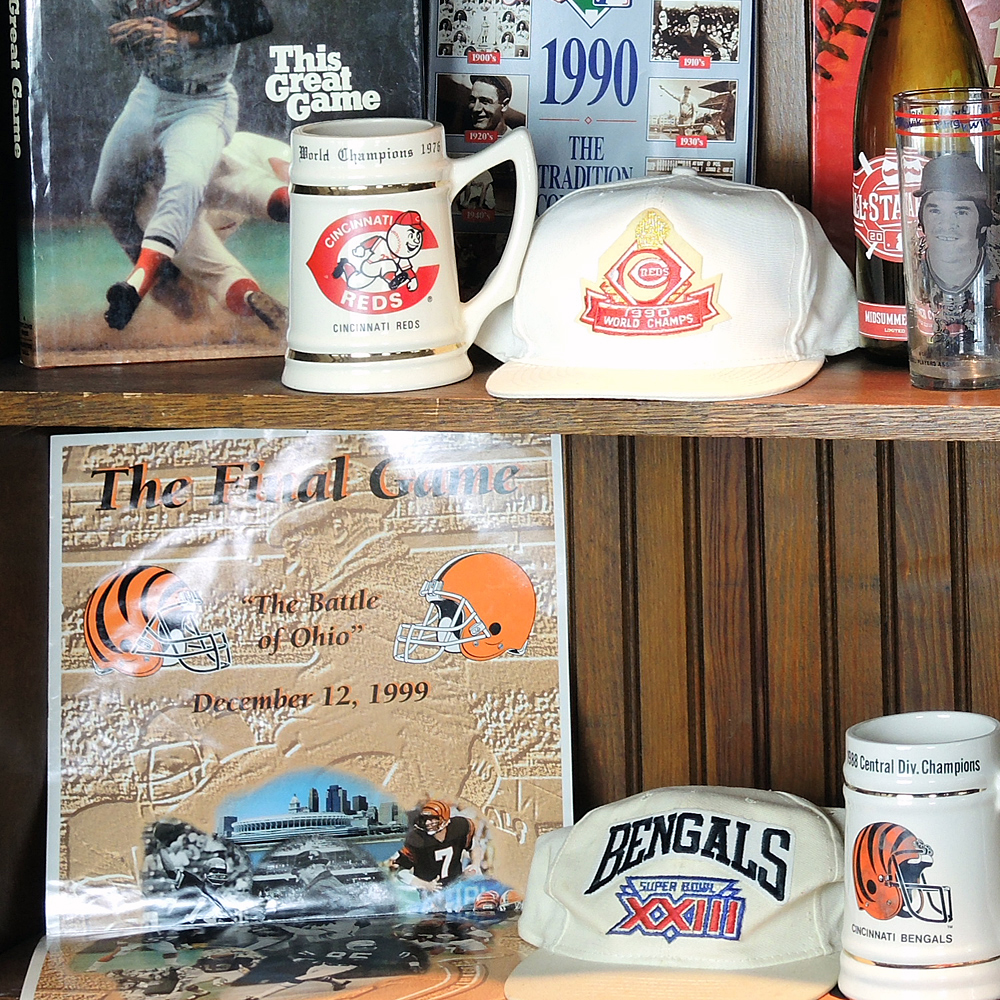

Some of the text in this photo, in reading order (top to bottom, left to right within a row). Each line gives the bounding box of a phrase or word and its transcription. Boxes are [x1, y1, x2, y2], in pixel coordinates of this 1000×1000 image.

[269, 44, 342, 73] This
[471, 52, 497, 63] 1900's
[683, 57, 706, 68] 1910's
[539, 36, 639, 107] 1990
[264, 66, 353, 103] Great
[11, 76, 23, 159] Game
[286, 89, 382, 122] Game
[468, 131, 494, 142] 1920's
[568, 135, 605, 161] THE
[680, 137, 704, 147] 1930's
[298, 142, 441, 165] World Champions 1976
[538, 166, 634, 190] TRADITION
[324, 213, 393, 249] CINCINNATI
[640, 267, 669, 277] REDS
[340, 289, 403, 311] REDS
[603, 313, 694, 329] WORLD CHAMPS
[624, 307, 671, 318] 1990
[332, 319, 421, 333] CINCINNATI REDS
[90, 453, 522, 512] The Final Game
[308, 588, 380, 612] Battle
[258, 623, 365, 656] of Ohio”
[192, 680, 430, 714] December 12, 1999
[859, 756, 981, 776] Central Div. Champions
[434, 846, 454, 879] 7
[583, 811, 792, 903] BENGALS
[639, 880, 717, 894] SUPER BOWL
[619, 895, 739, 935] XXIII
[851, 922, 954, 944] CINCINNATI BENGALS
